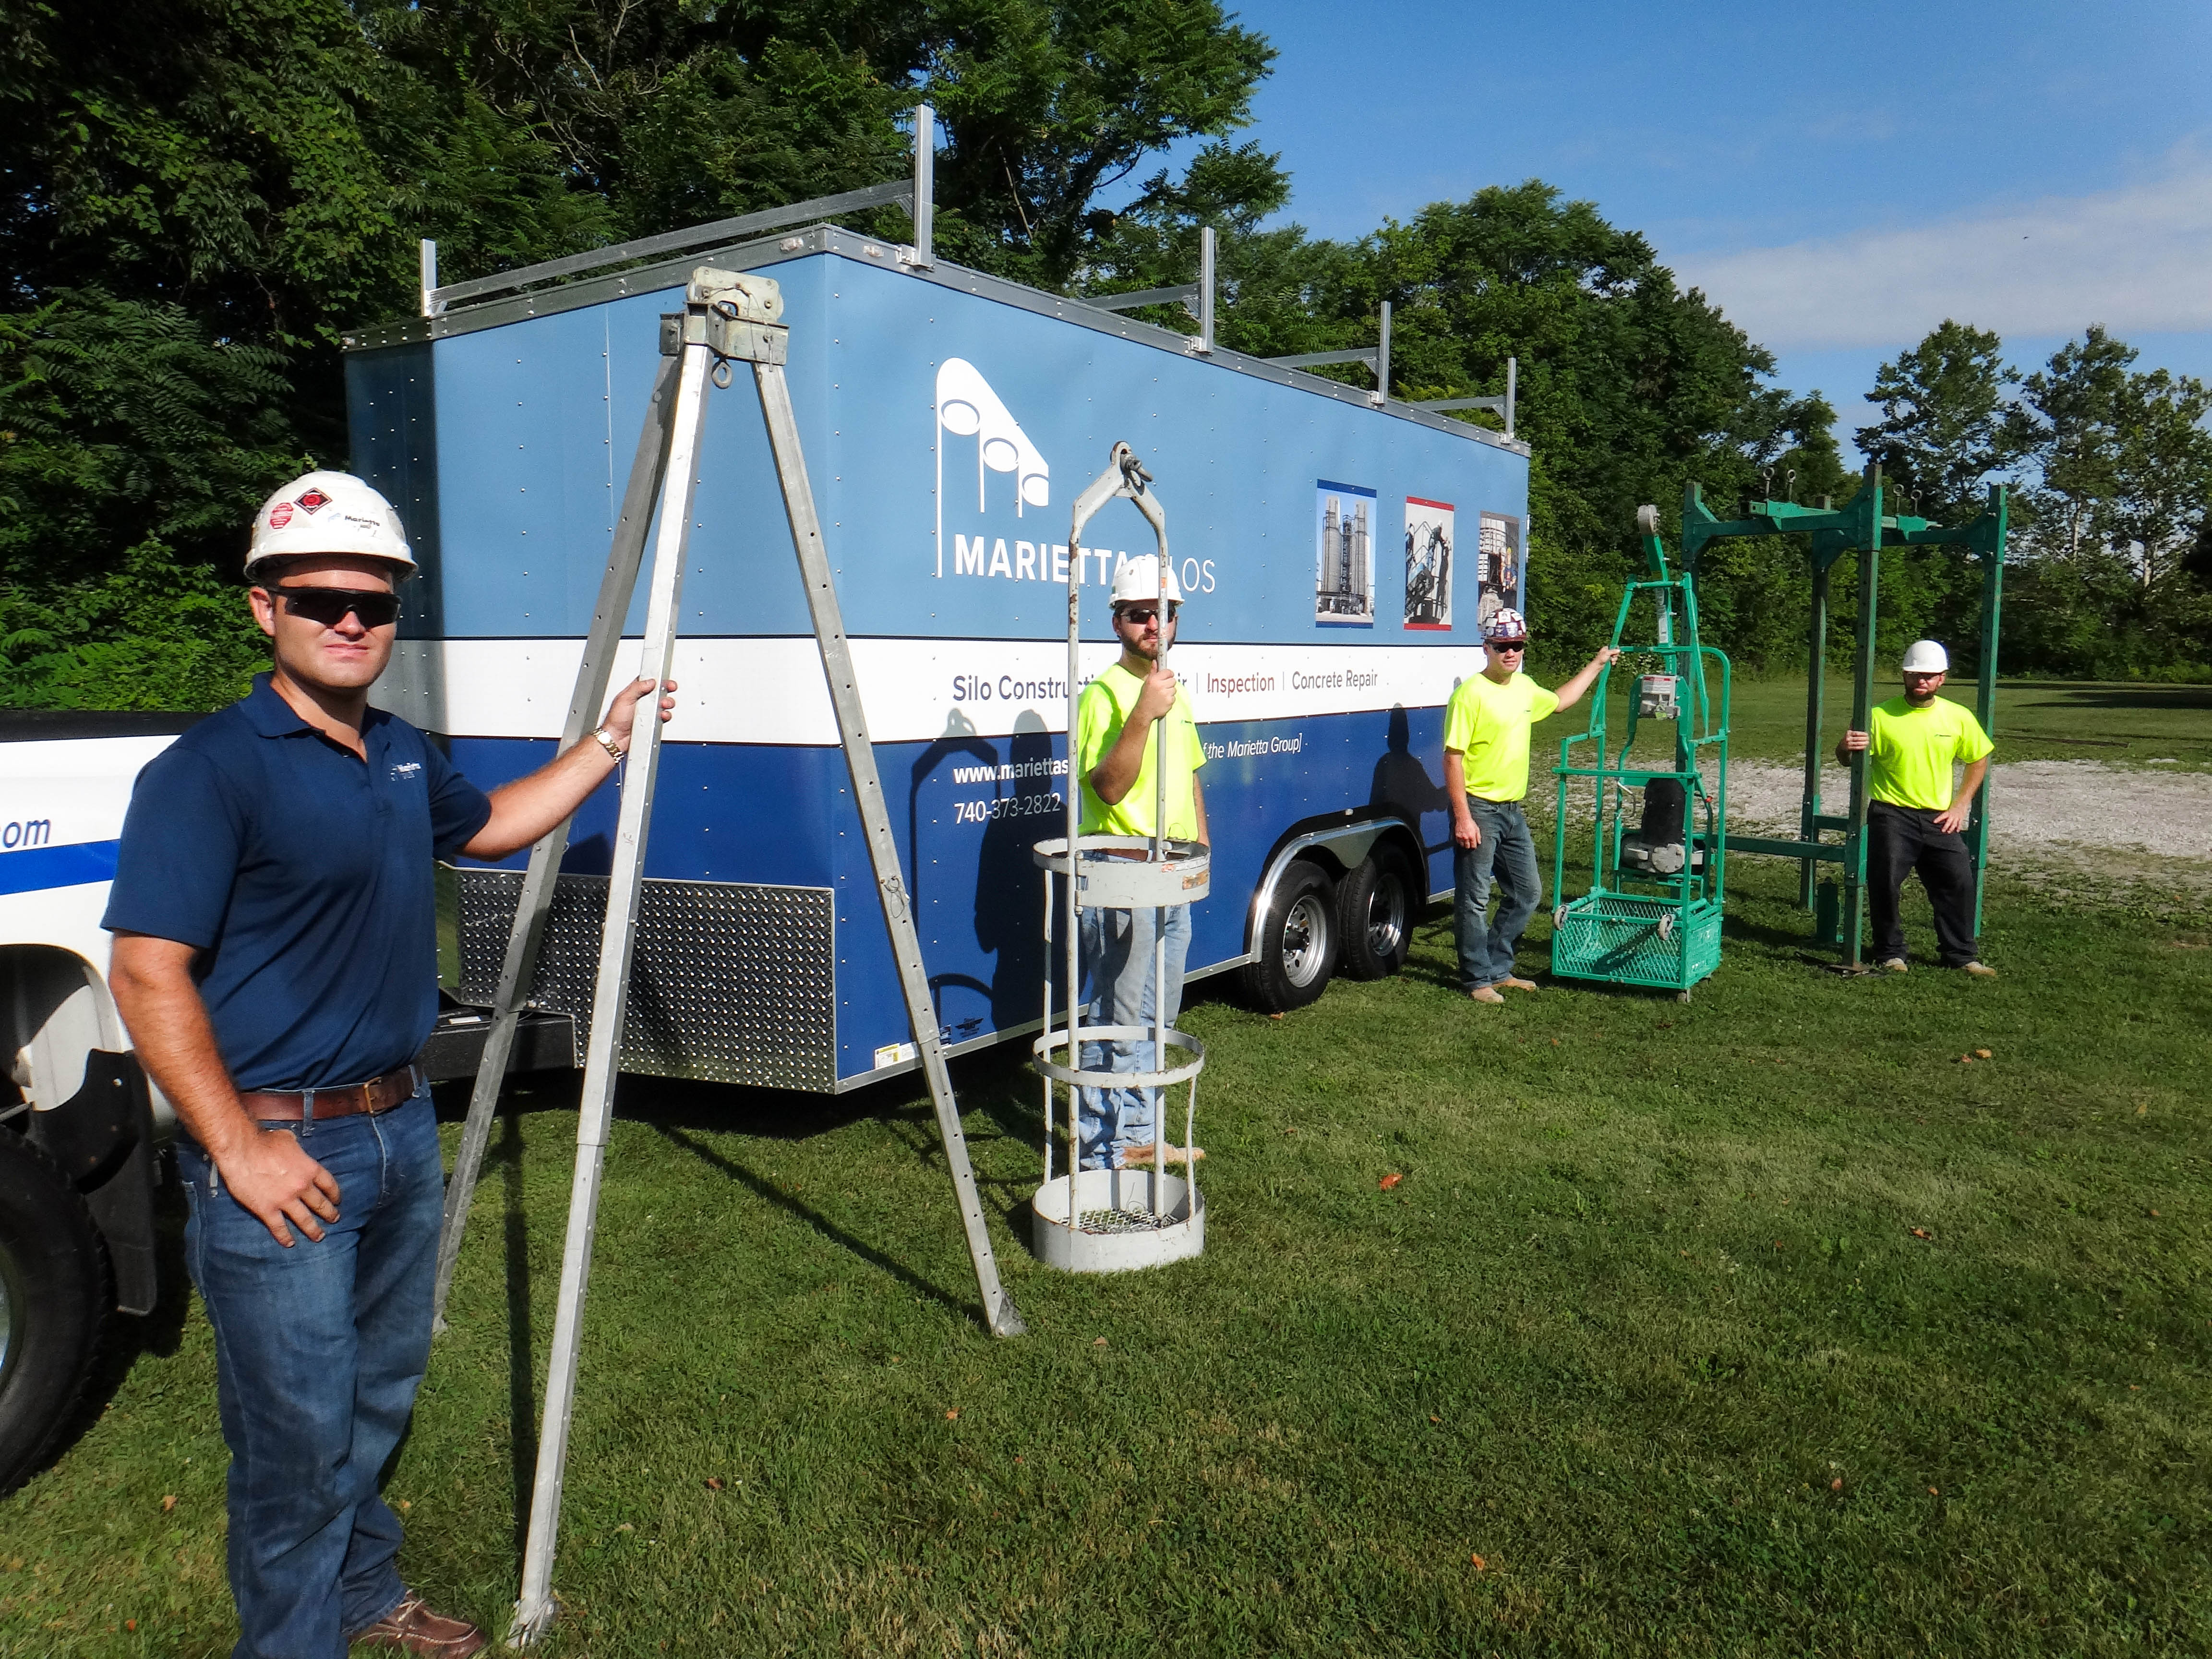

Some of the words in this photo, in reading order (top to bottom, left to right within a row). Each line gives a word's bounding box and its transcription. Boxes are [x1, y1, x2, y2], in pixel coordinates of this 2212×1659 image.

[952, 674, 992, 701] Silo
[998, 673, 1094, 700] Constru
[1207, 672, 1274, 698] Inspection
[1292, 671, 1343, 690] Concrete
[1346, 668, 1378, 691] Repair
[1208, 742, 1225, 759] the
[1227, 739, 1269, 758] Marietta
[1271, 732, 1303, 754] Group]
[953, 757, 1069, 784] www.mariettas
[953, 792, 1061, 824] 740-373-2822
[0, 819, 51, 848] om
